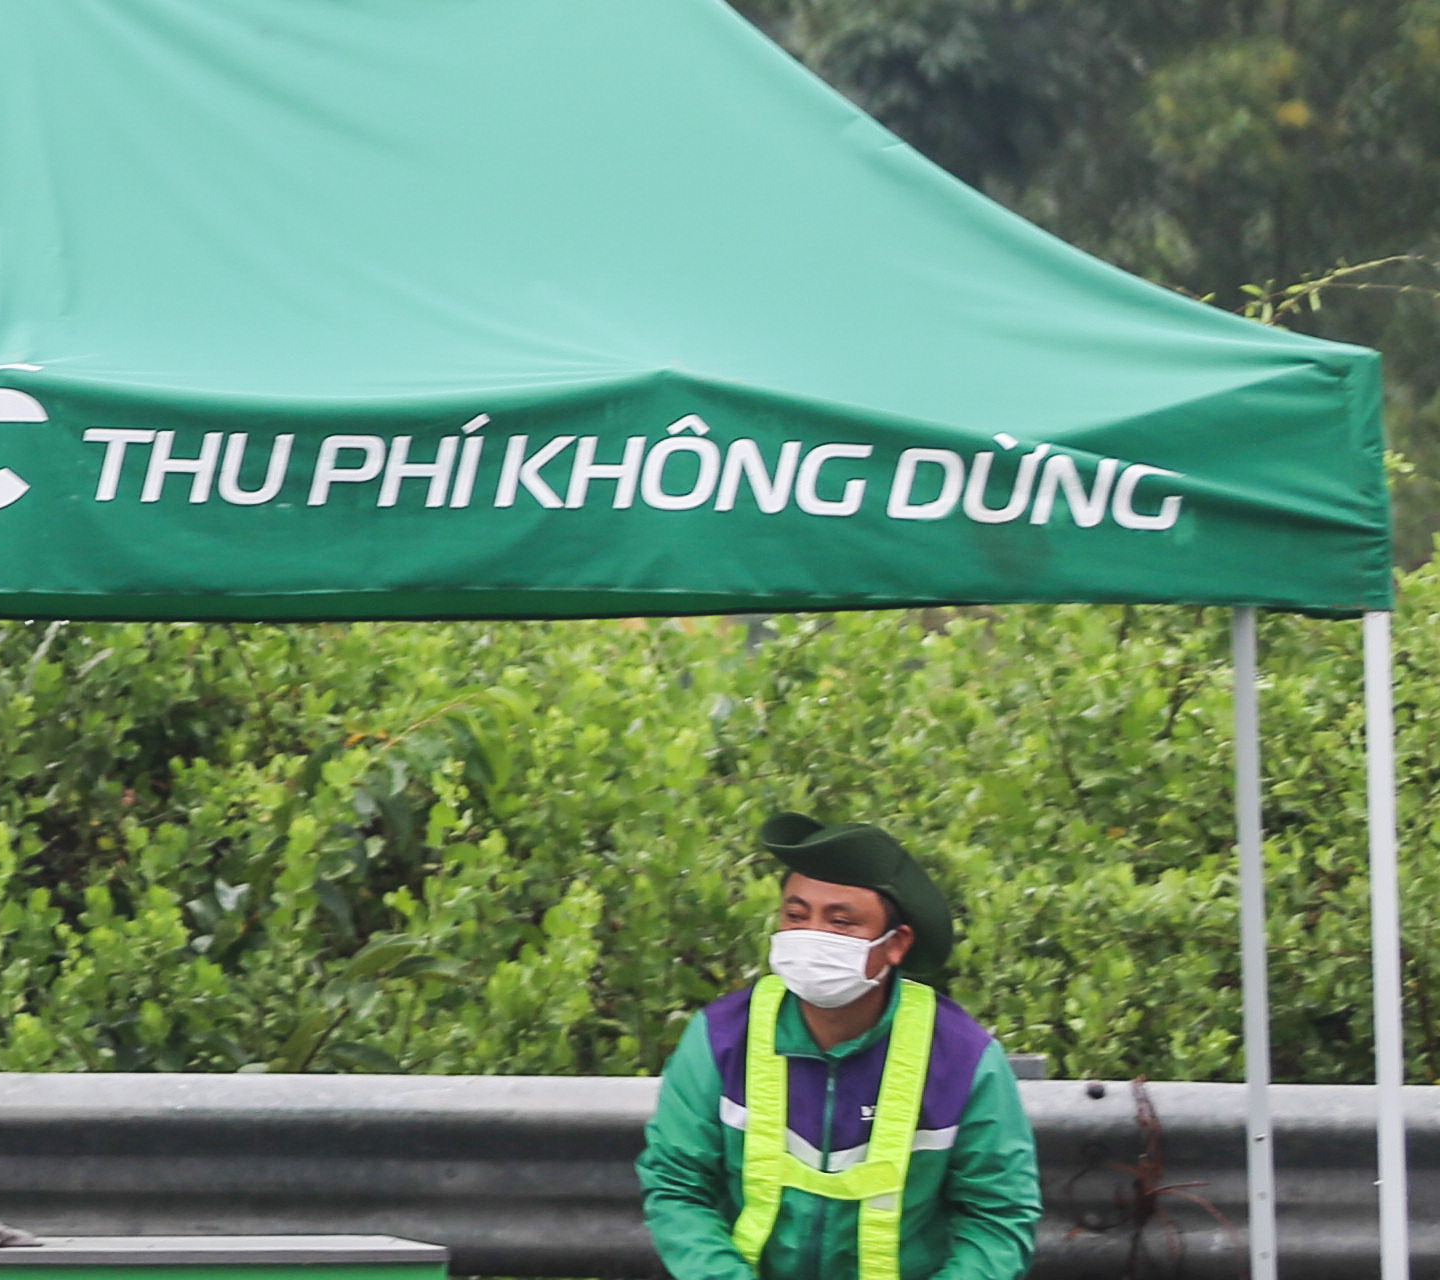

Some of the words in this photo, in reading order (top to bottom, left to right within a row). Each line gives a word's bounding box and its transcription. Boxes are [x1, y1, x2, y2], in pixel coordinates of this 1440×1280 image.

[82, 427, 293, 506] THU
[306, 412, 492, 509] PHÍ
[493, 413, 873, 517] KHÔNG
[886, 431, 1187, 531] DỪNG
